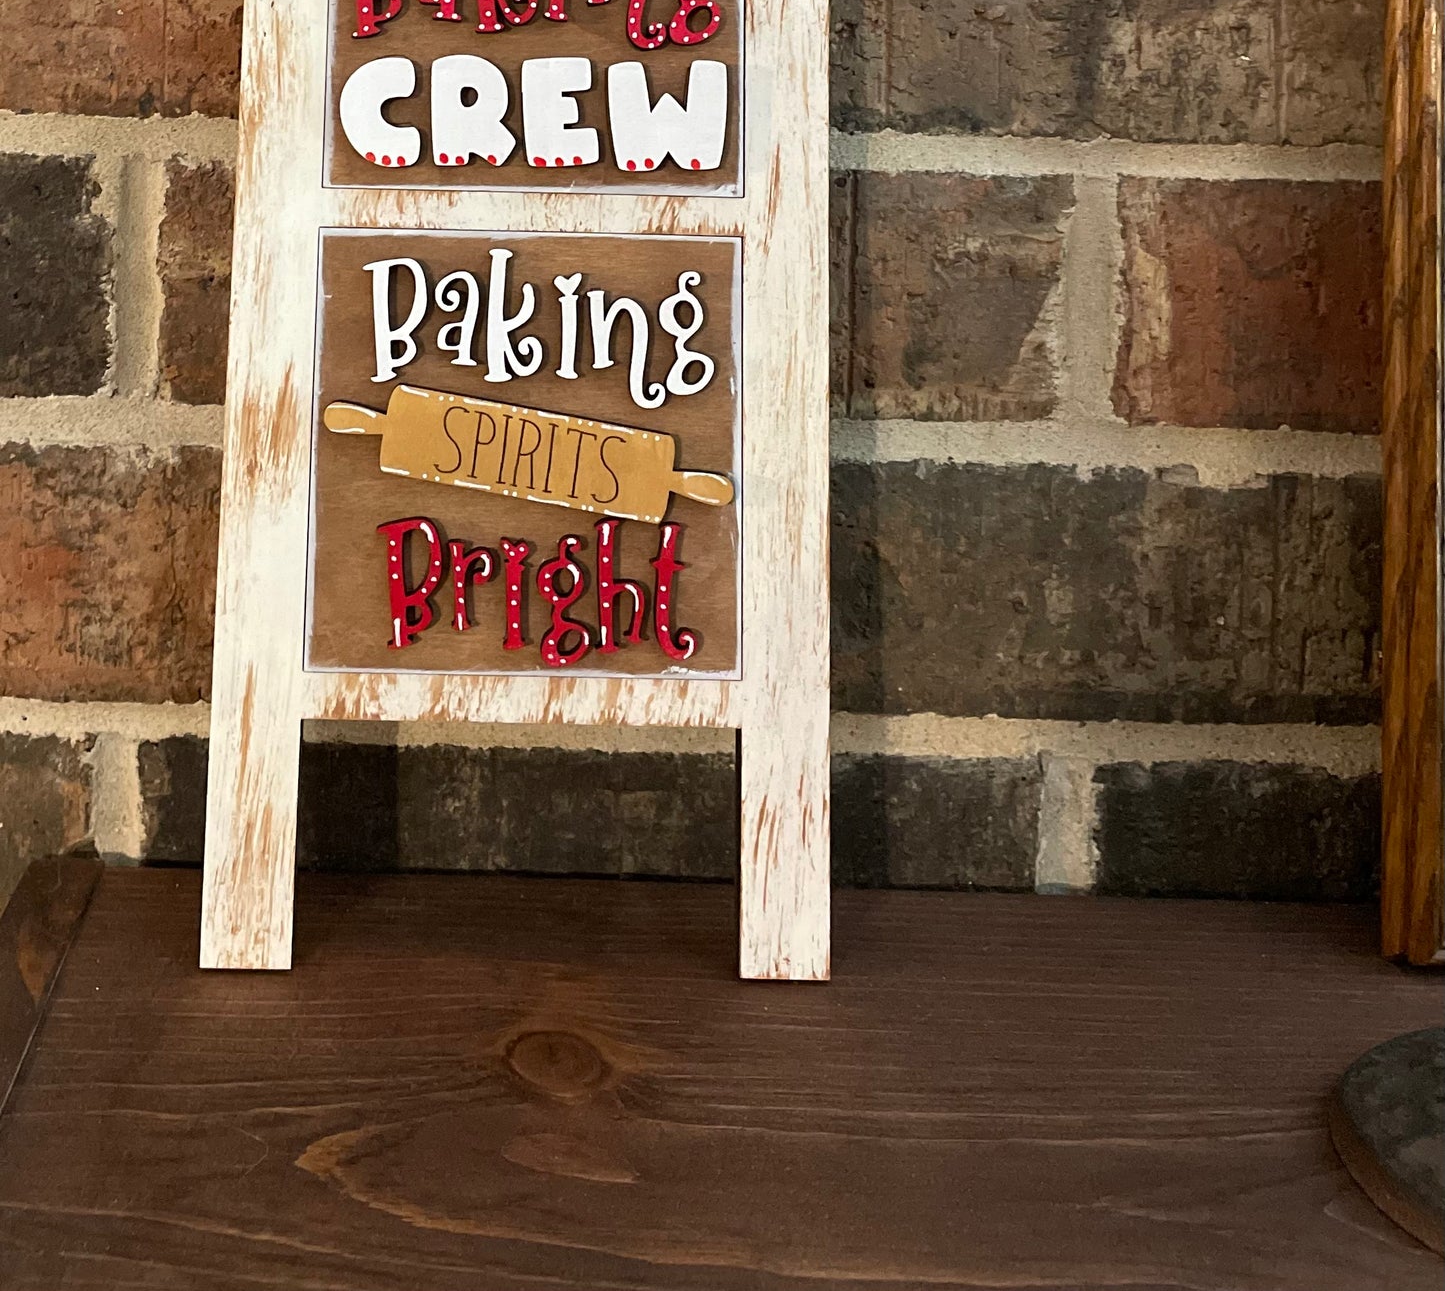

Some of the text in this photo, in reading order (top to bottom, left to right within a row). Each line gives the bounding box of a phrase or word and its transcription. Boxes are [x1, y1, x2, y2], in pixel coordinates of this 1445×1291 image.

[339, 54, 728, 171] CREW
[362, 248, 715, 409] Baking
[433, 406, 626, 504] SPIRITS
[376, 516, 697, 668] Bright
